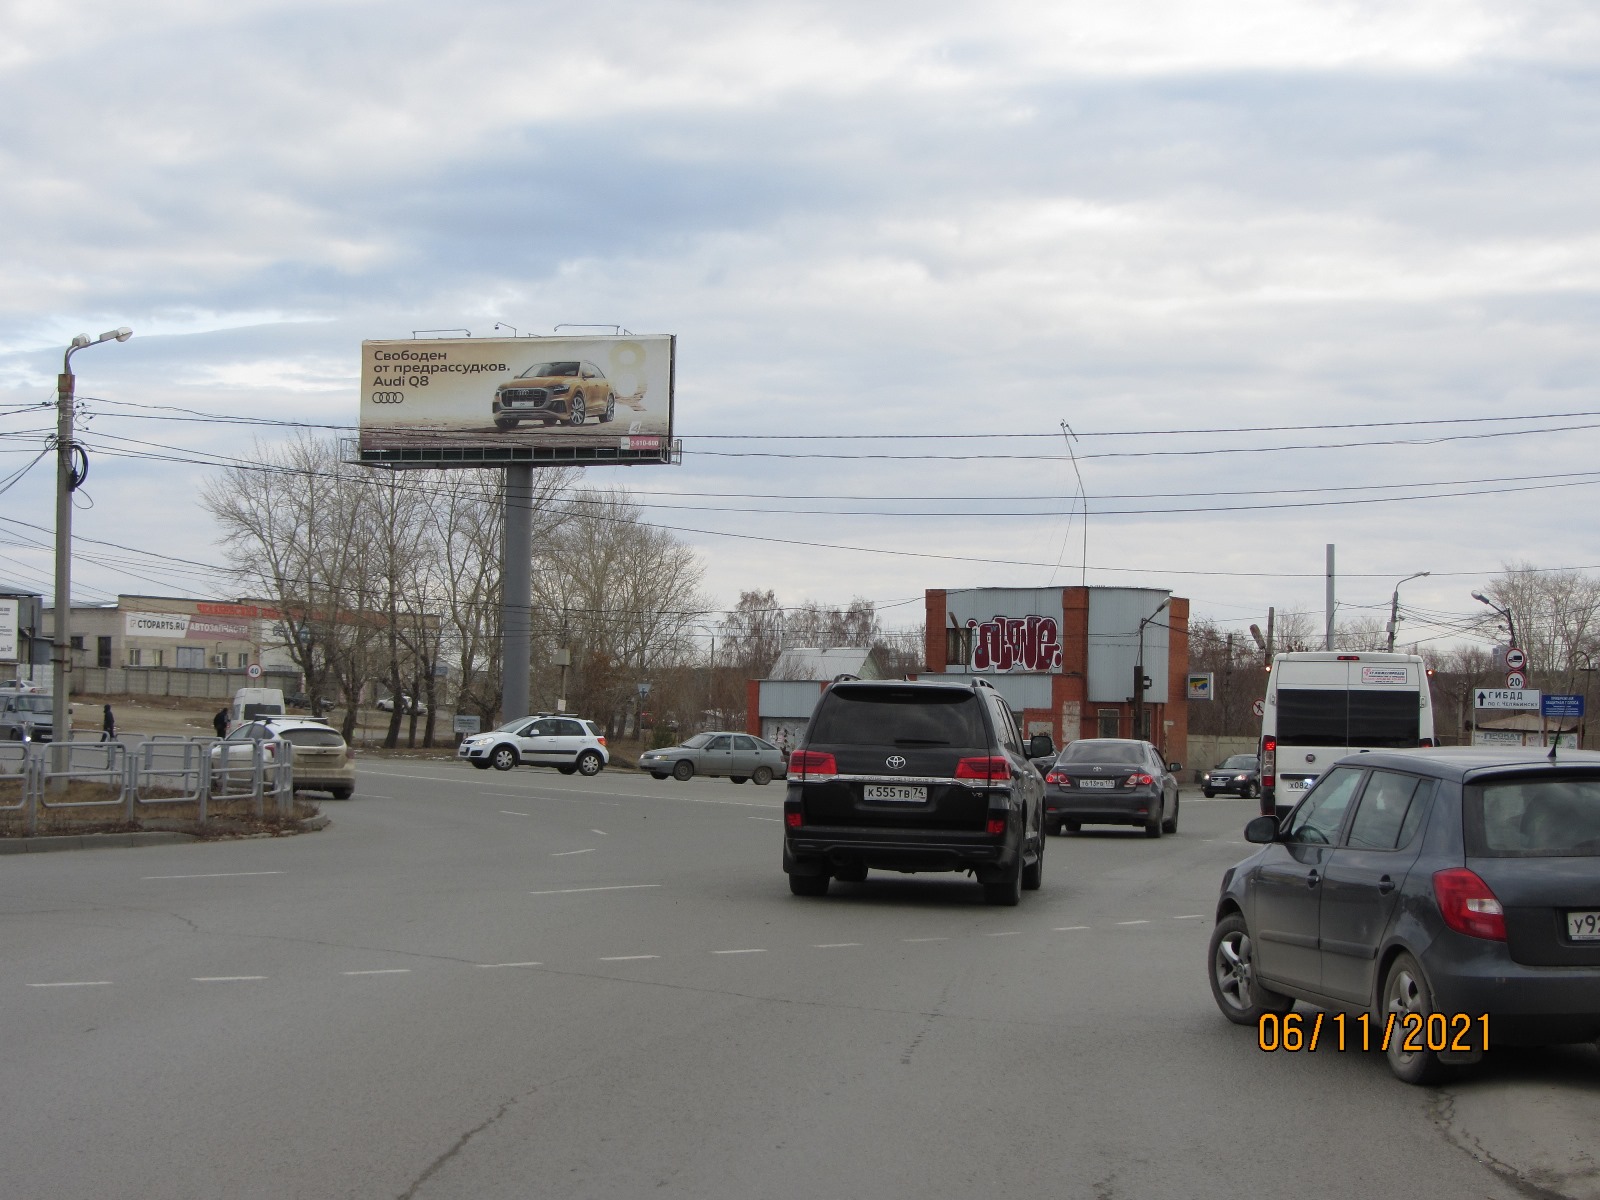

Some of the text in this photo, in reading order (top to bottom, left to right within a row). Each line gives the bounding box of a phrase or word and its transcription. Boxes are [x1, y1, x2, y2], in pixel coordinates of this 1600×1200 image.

[374, 350, 447, 362] Свободен
[373, 363, 511, 375] от предрассудков.
[373, 375, 430, 388] Audi Q8
[250, 667, 259, 675] 40
[1488, 691, 1523, 701] ГИБДД
